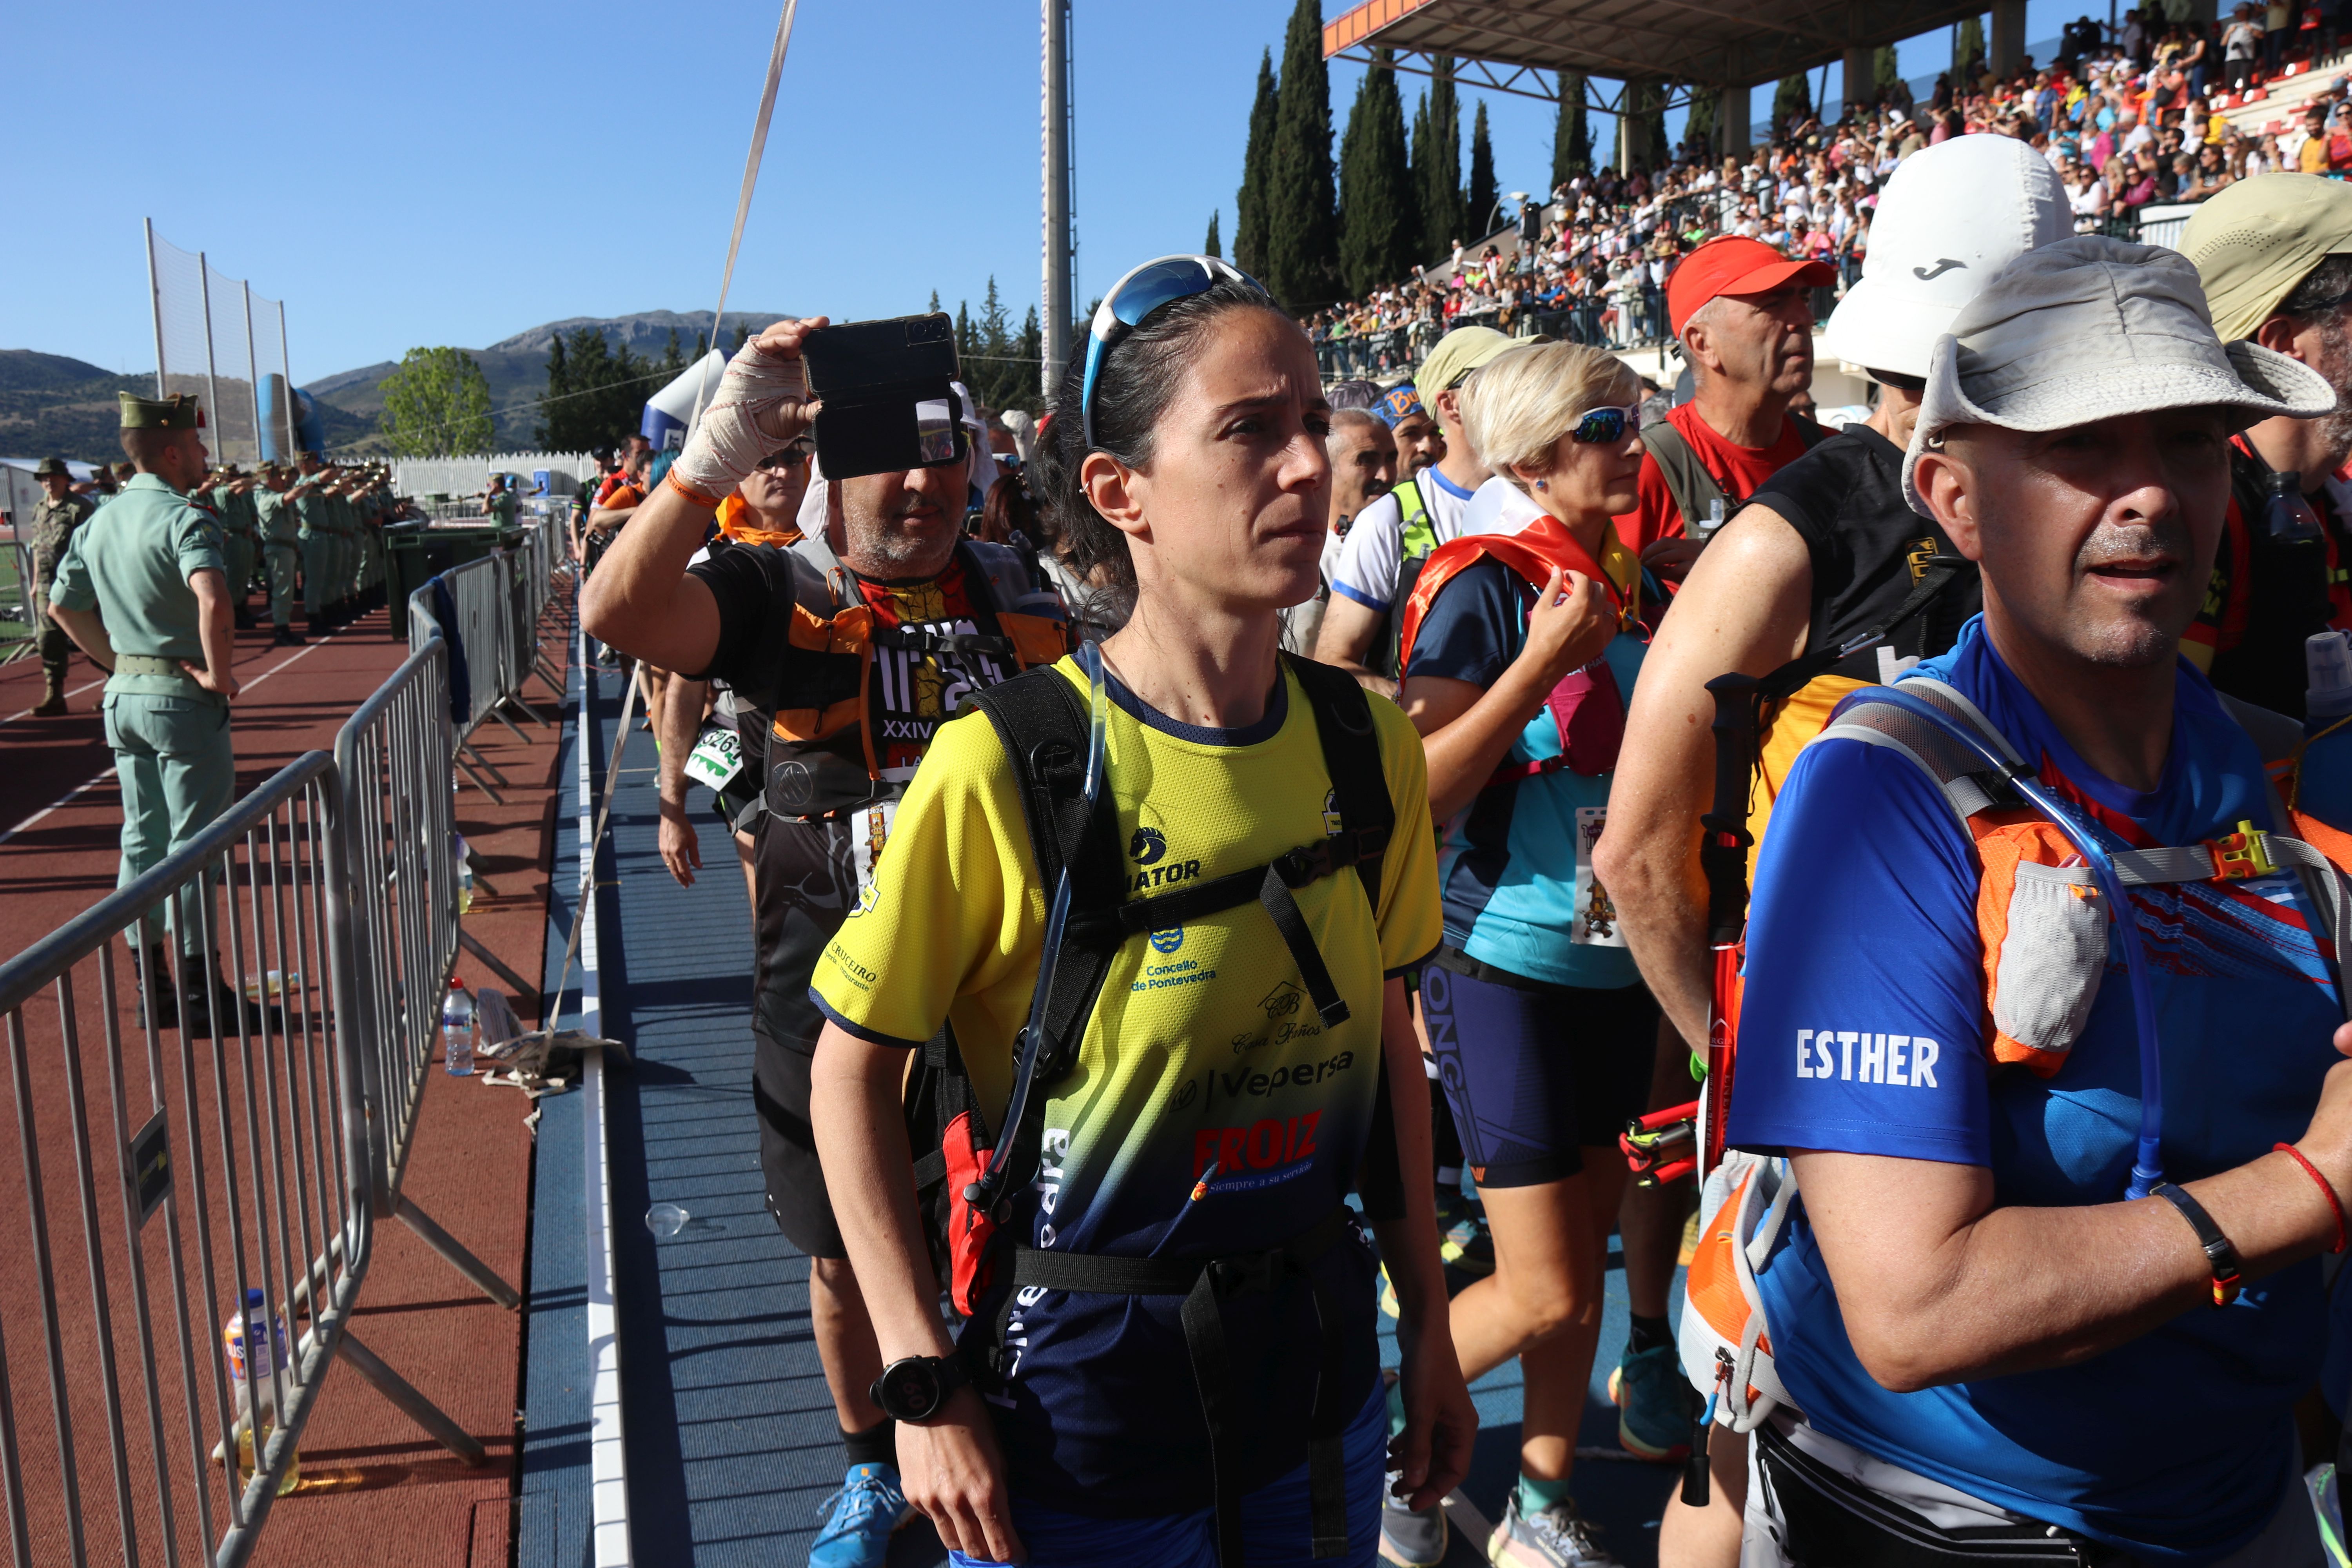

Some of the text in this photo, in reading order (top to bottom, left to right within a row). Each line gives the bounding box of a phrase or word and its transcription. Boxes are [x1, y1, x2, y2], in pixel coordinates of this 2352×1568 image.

[1385, 390, 1420, 414] Bu
[883, 720, 933, 739] XXIV
[1126, 860, 1200, 893] IATOR
[832, 942, 876, 982] CRUCEIRO
[1147, 960, 1198, 976] Concello
[1131, 970, 1216, 992] de Pontevedra
[1221, 1051, 1354, 1098] Vepersa
[1796, 1029, 1939, 1089] ESTHER
[1192, 1109, 1324, 1178] FROIZ
[1209, 1179, 1255, 1193] Siempre
[1269, 1174, 1280, 1184] su
[1283, 1162, 1312, 1179] servicio
